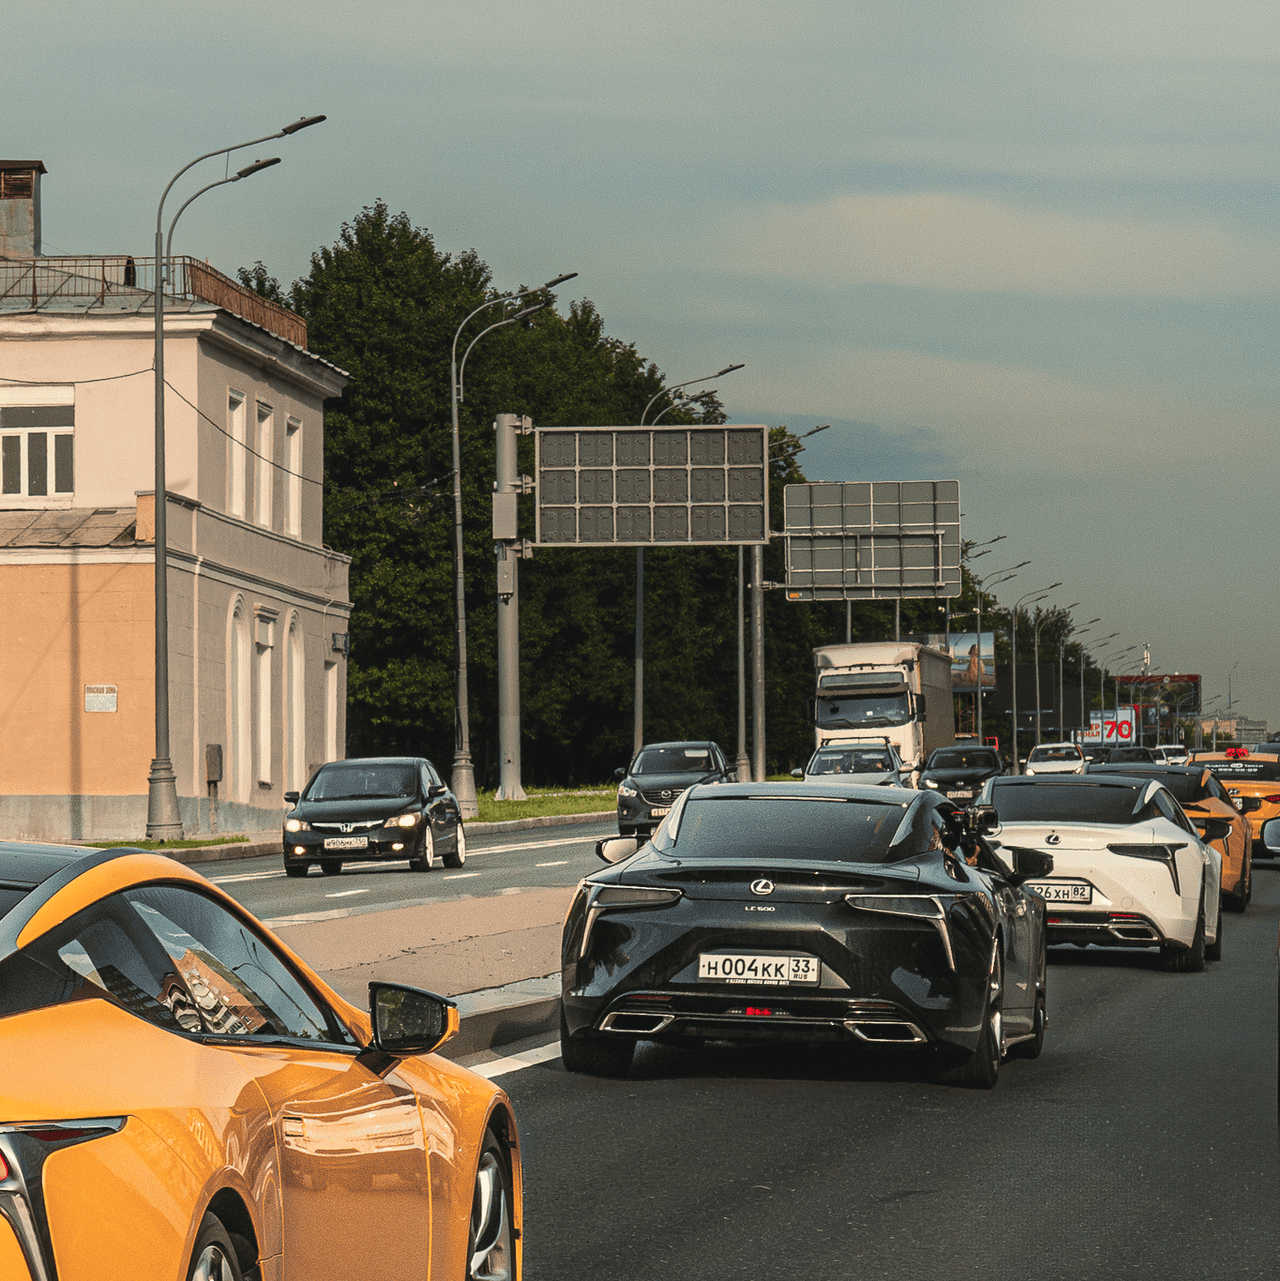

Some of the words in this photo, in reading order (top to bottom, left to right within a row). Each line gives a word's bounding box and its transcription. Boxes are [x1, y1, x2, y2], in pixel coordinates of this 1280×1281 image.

[1104, 720, 1131, 739] 70
[1073, 887, 1086, 897] 82
[792, 959, 811, 973] 33
